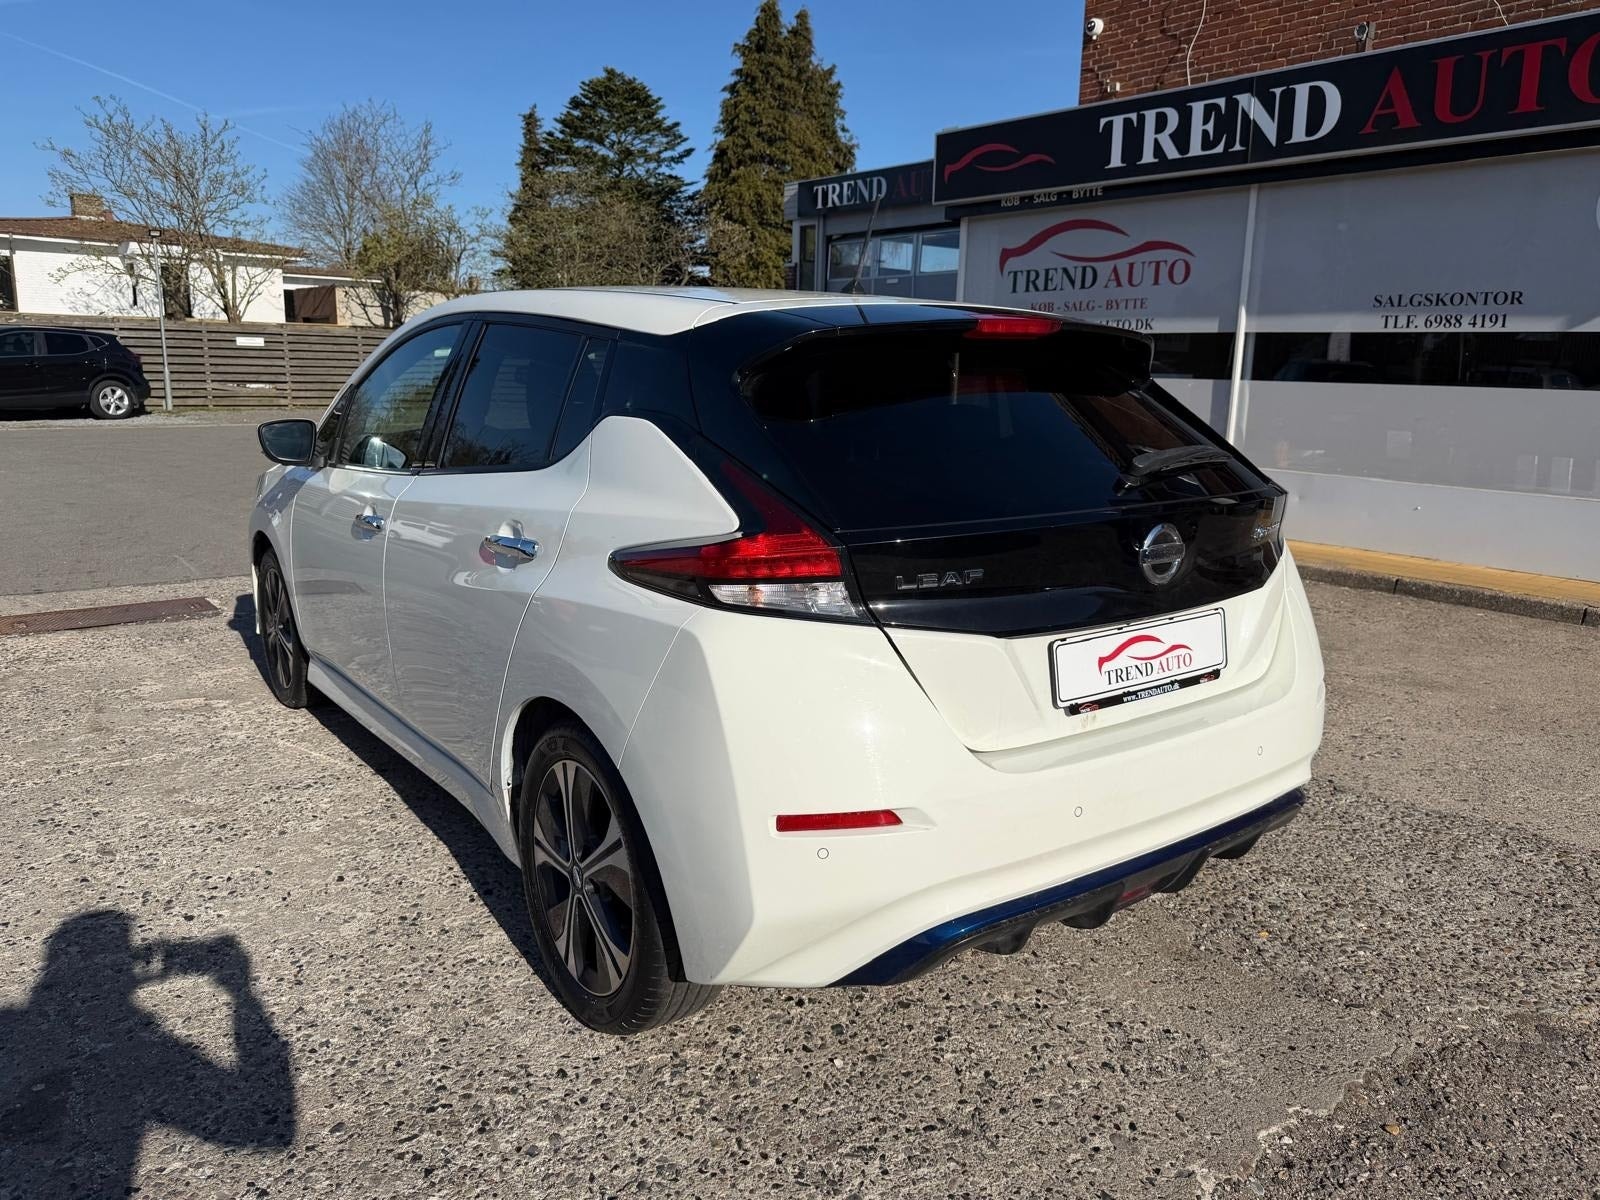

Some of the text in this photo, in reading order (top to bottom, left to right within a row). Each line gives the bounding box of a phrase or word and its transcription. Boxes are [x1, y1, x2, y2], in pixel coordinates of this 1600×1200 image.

[1098, 80, 1342, 169] TREND
[813, 176, 888, 209] TREND
[1032, 191, 1058, 205] SALG
[1071, 185, 1105, 200] BYTTE
[1007, 258, 1192, 294] TREND AUTO
[1063, 300, 1096, 312] SALG
[1105, 297, 1149, 311] BYTTE
[1372, 290, 1524, 308] SALGSKONTOR
[1381, 313, 1508, 329] TLF. 6988 4191
[896, 568, 985, 590] LEAF
[1105, 652, 1193, 686] TREND AUTO
[1122, 682, 1180, 703] www.TRENDAUTO.dk
